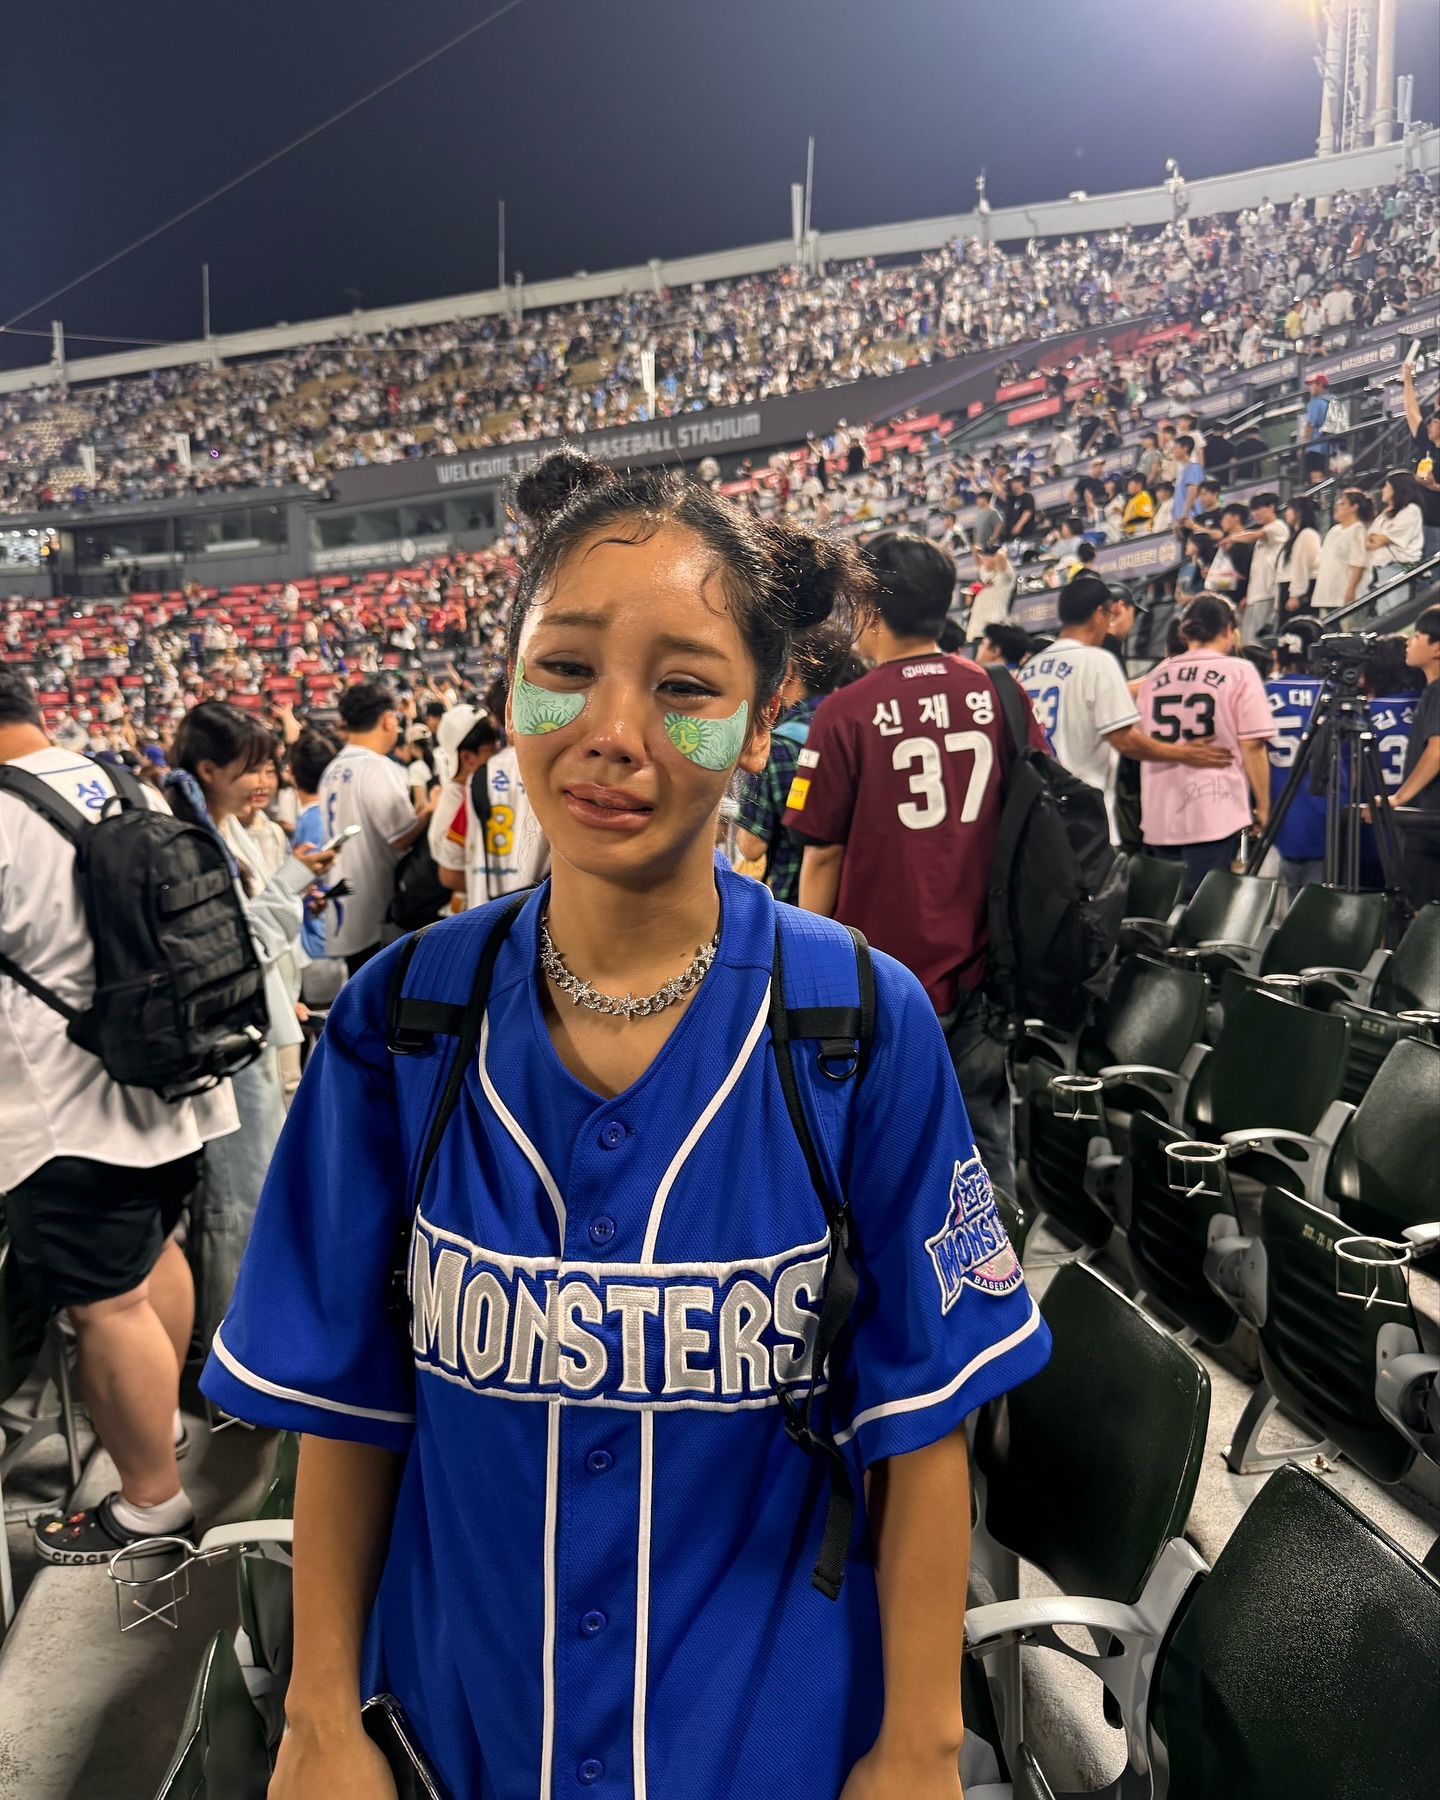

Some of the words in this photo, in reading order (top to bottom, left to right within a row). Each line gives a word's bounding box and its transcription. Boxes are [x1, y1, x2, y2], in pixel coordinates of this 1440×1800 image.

[436, 455, 513, 484] WELCOME
[587, 429, 675, 460] BASEBALL
[677, 412, 762, 448] STADIUM
[1152, 666, 1225, 691] 고대한
[1267, 689, 1312, 712] 고대
[872, 690, 995, 736] 신재영
[1151, 693, 1216, 744] 53
[892, 730, 994, 830] 37
[412, 1228, 829, 1395] MONSTERS
